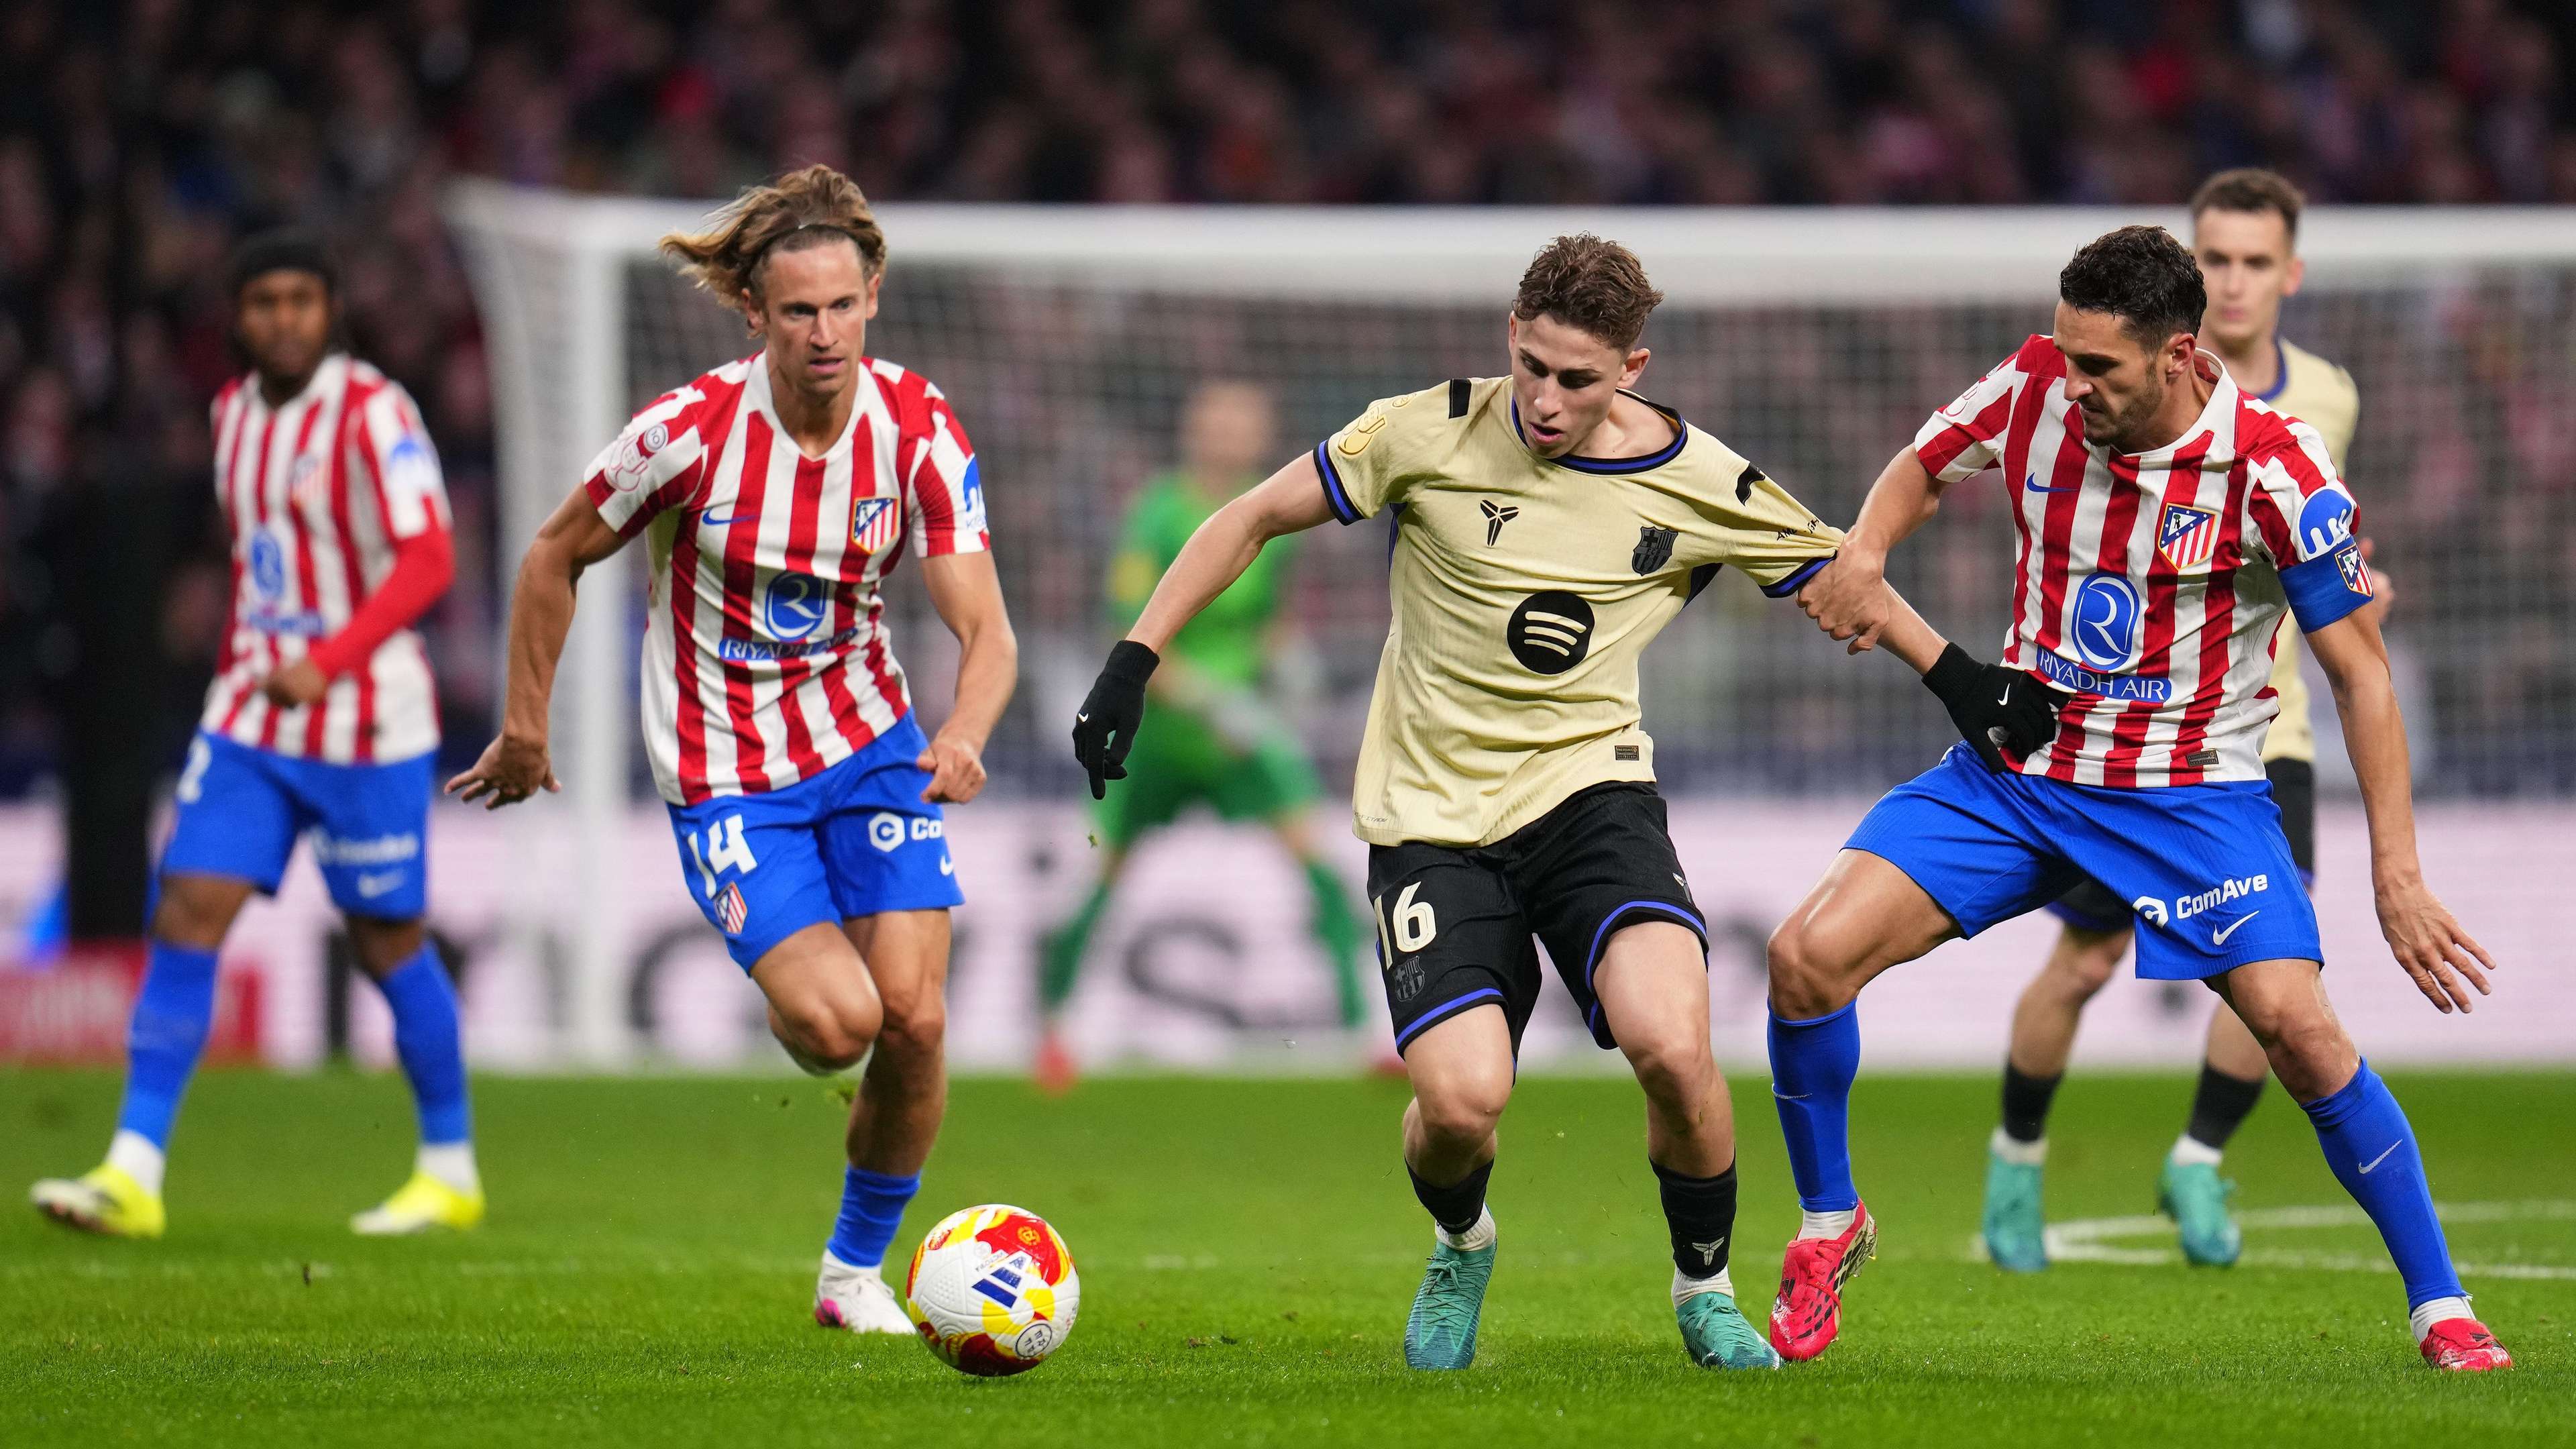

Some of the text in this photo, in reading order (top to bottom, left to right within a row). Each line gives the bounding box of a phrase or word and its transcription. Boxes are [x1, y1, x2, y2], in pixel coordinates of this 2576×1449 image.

[2040, 648, 2165, 700] RIYADH AIR
[911, 816, 942, 840] Co
[688, 814, 757, 899] 14
[2176, 874, 2268, 920] ComAve
[1374, 881, 1437, 971] 16
